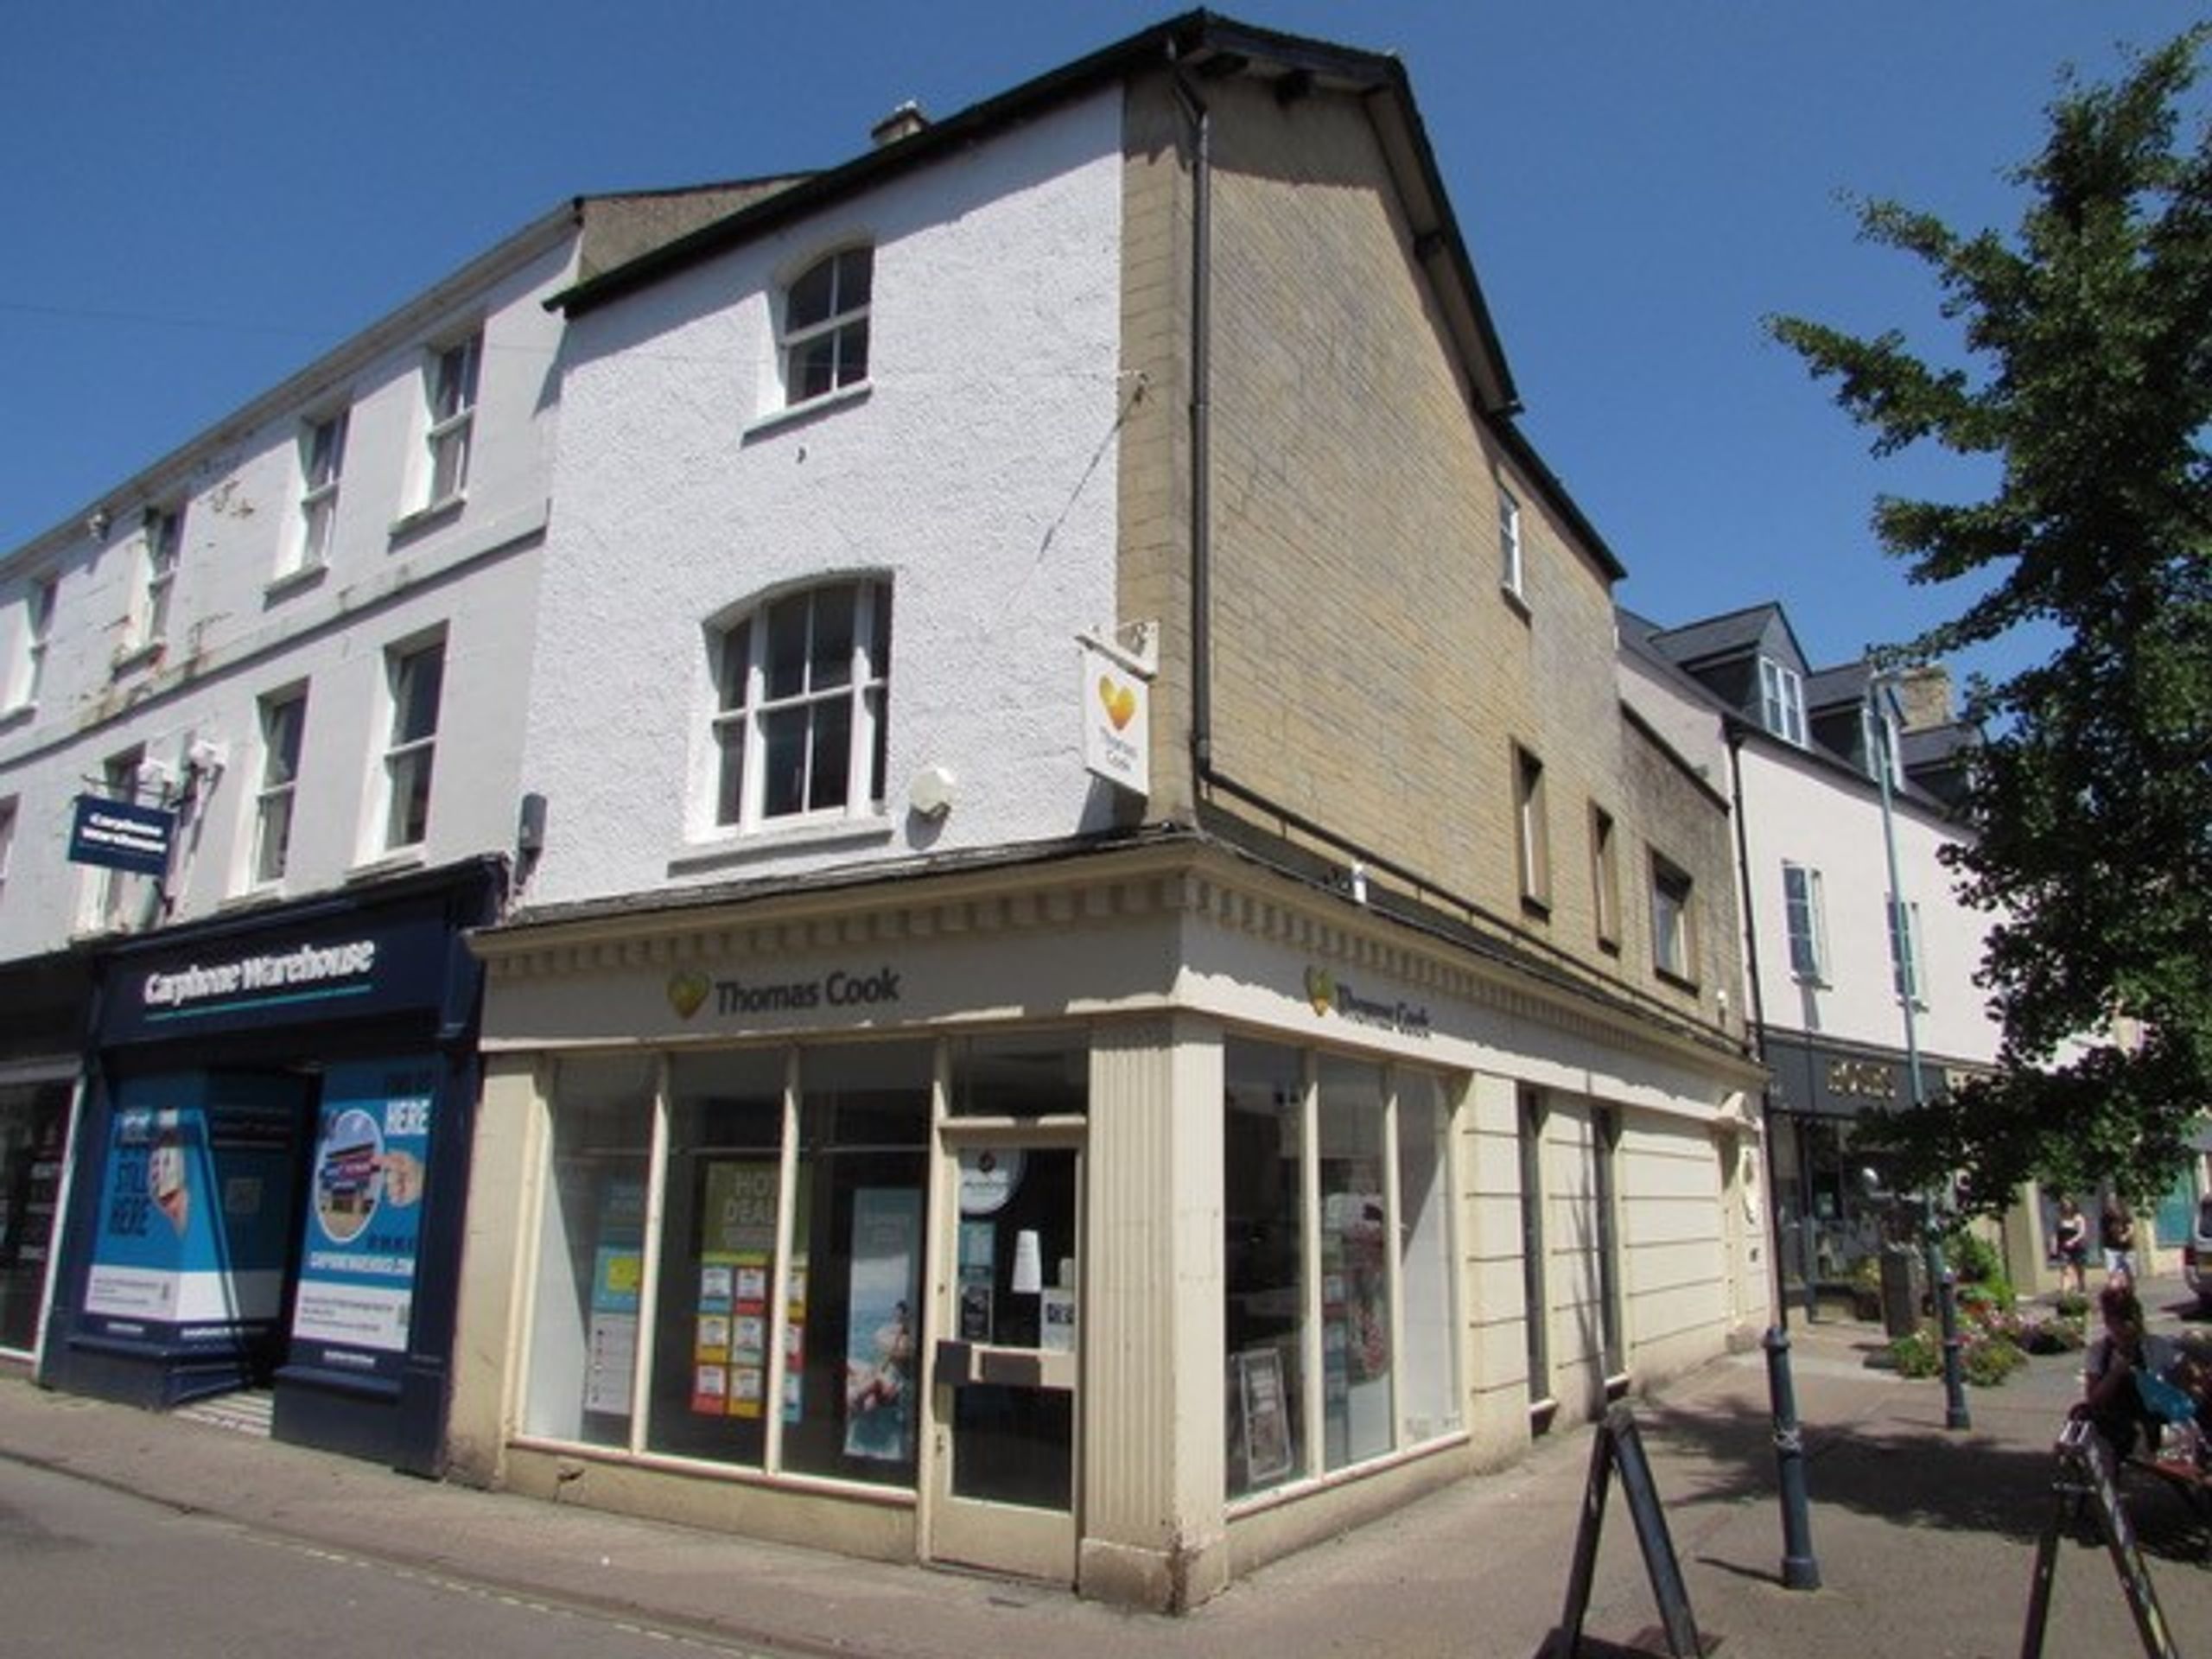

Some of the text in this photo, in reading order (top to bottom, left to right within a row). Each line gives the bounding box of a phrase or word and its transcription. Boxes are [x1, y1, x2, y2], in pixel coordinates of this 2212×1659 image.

[144, 940, 375, 1007] Carphone Warehouse
[715, 967, 901, 1016] Thomas Cook
[384, 1097, 431, 1135] HERE
